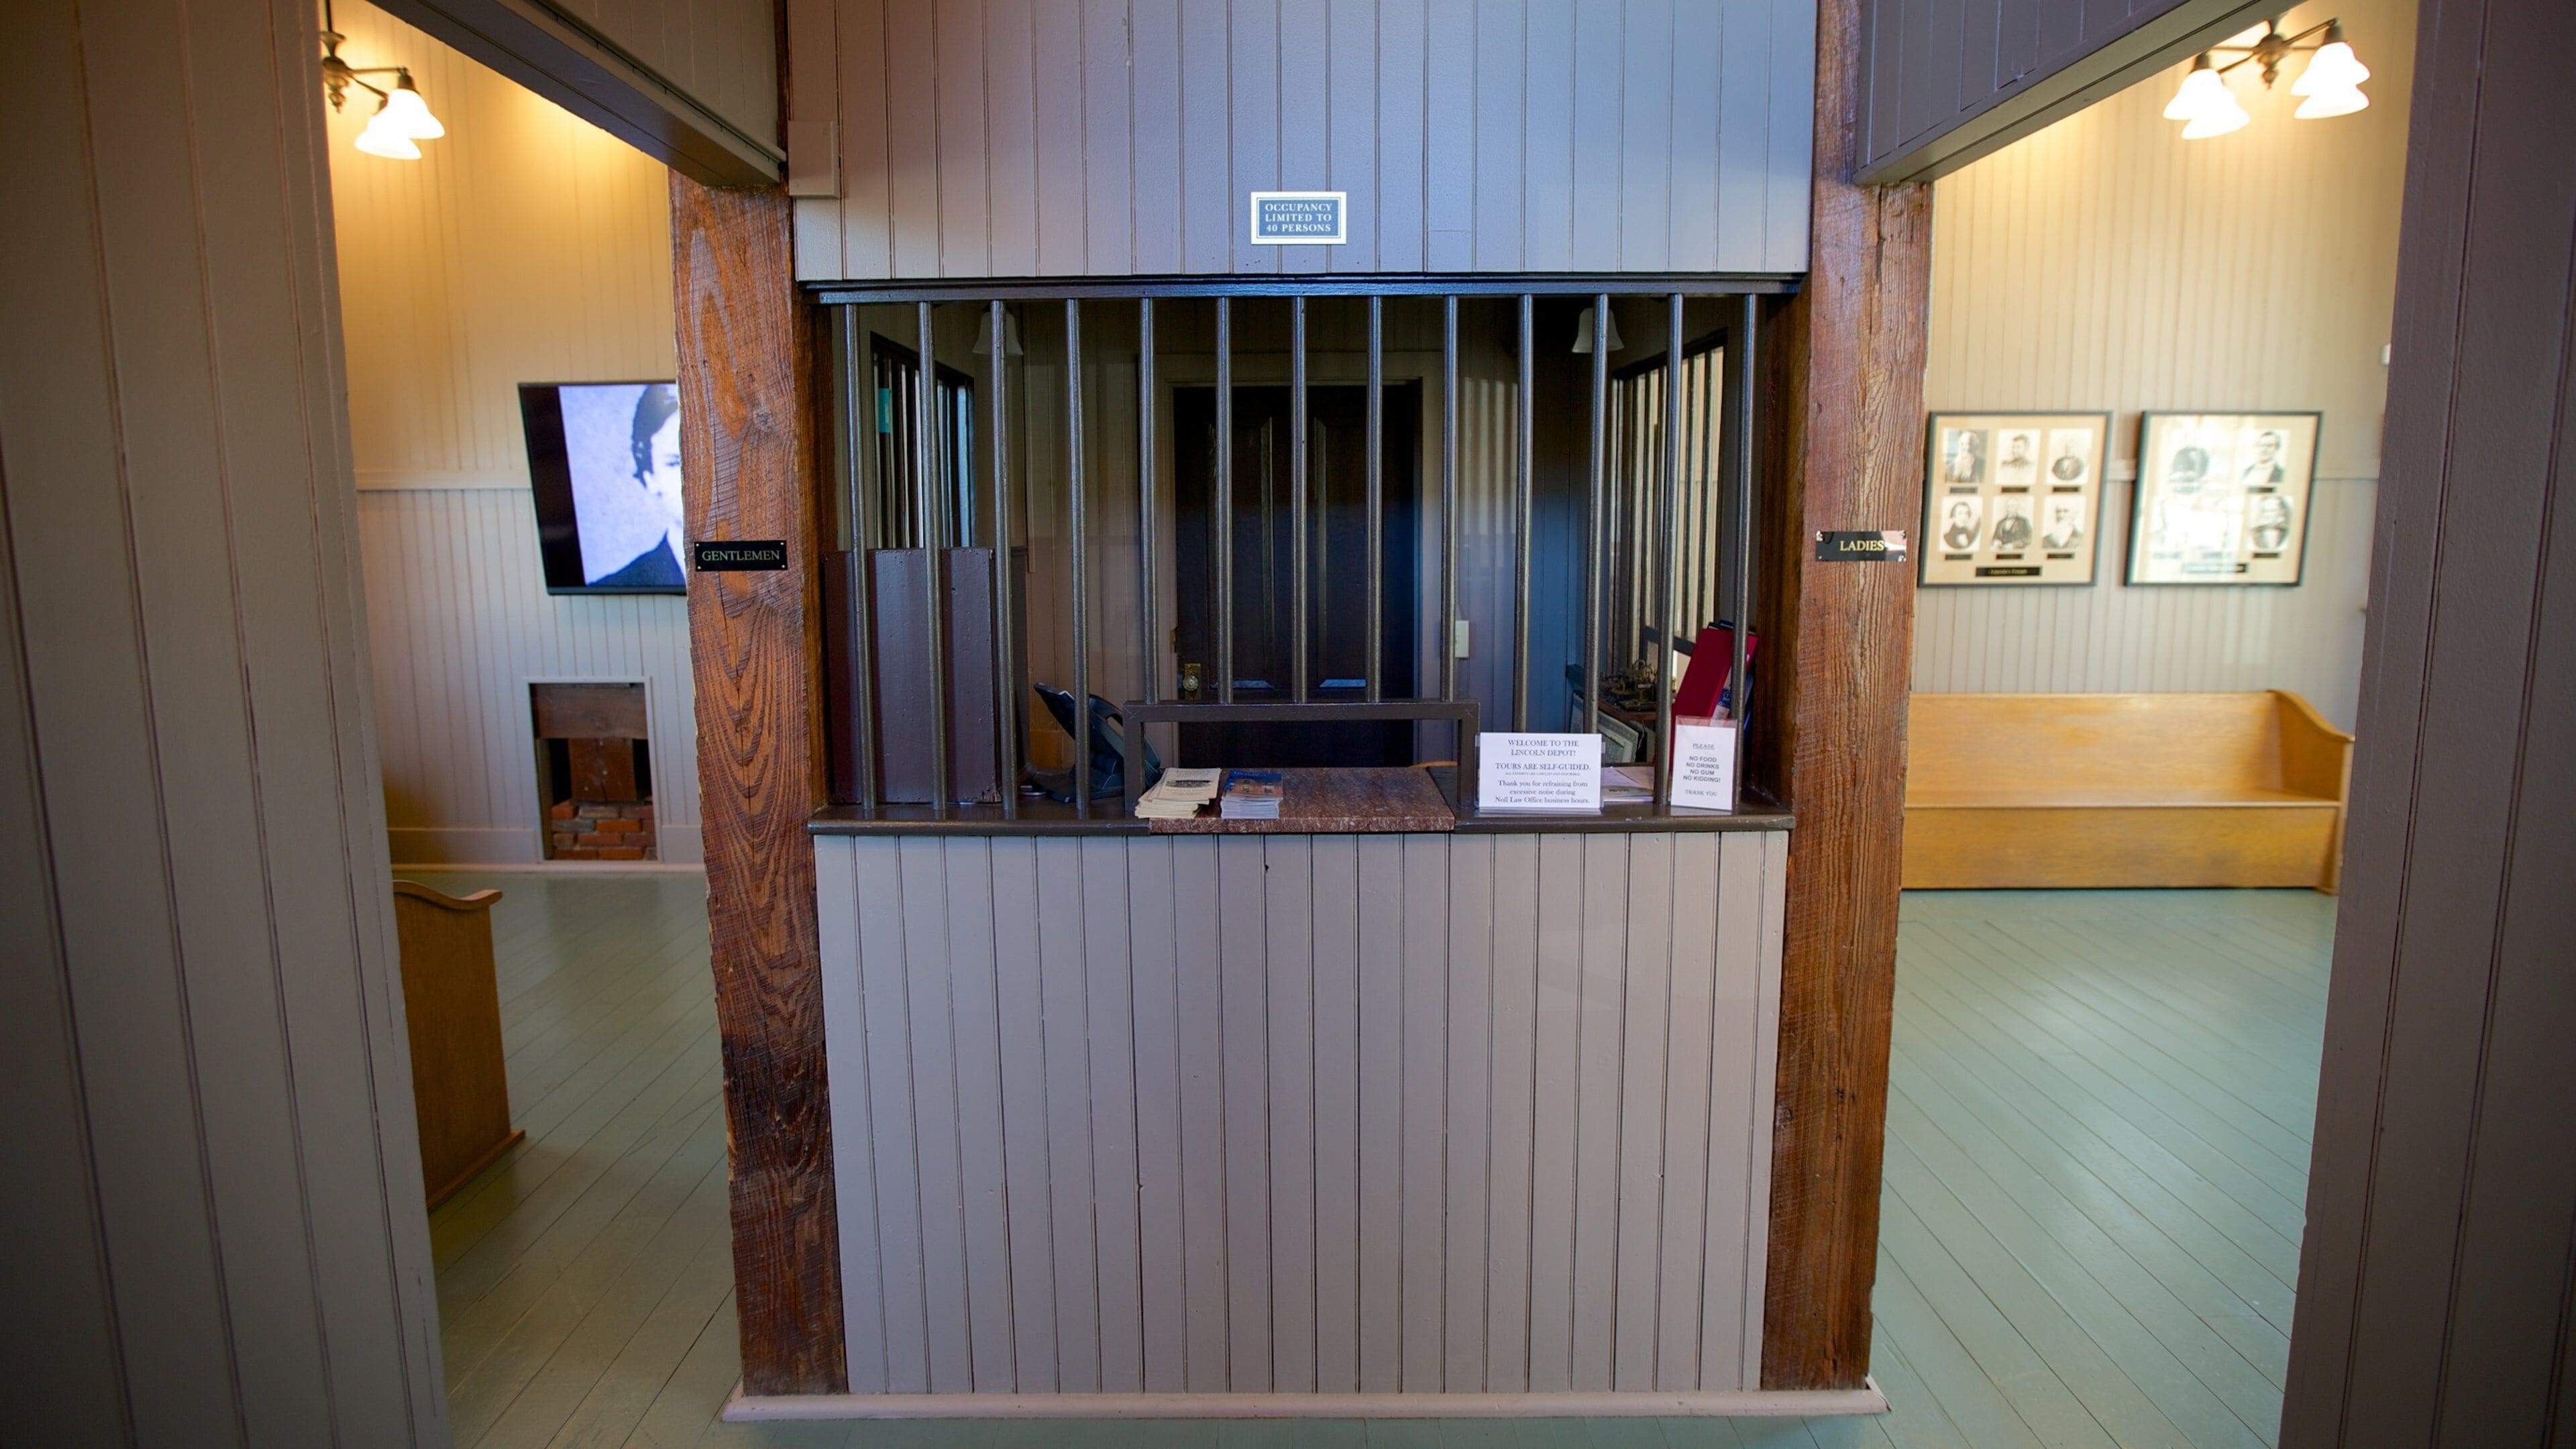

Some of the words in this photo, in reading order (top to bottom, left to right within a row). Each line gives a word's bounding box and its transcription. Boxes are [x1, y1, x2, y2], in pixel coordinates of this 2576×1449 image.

[1265, 203, 1332, 212] OCCUPANCY
[1265, 213, 1312, 222] LIMITED
[1316, 213, 1332, 222] TO
[1267, 224, 1278, 232] 40
[1282, 224, 1331, 232] PERSONS
[1839, 540, 1884, 551] LADIES
[702, 549, 780, 561] GENTLEMEN
[1495, 762, 1521, 770] TOURS
[1539, 763, 1591, 771] SELF-GUIDED.
